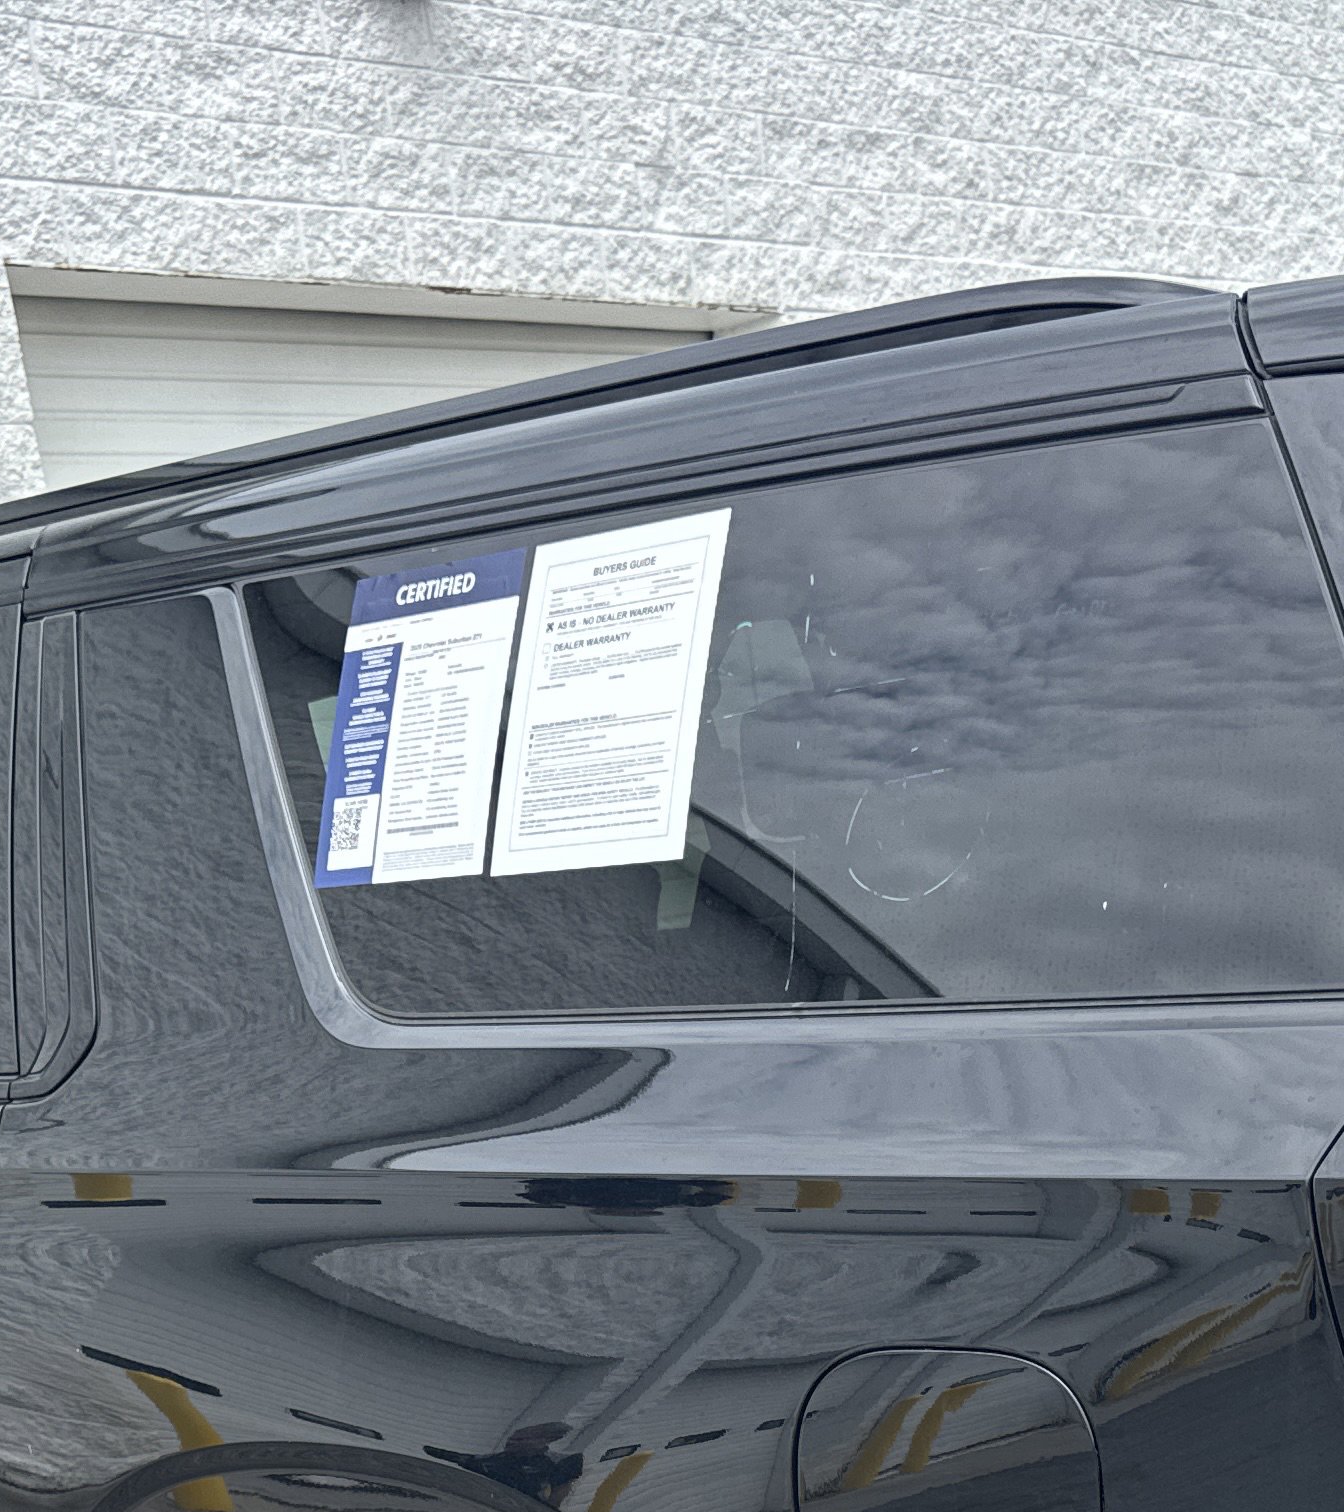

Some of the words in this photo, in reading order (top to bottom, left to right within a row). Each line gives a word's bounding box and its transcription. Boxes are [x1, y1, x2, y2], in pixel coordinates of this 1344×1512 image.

[593, 561, 628, 577] BUYERS
[629, 555, 657, 571] GUIDE
[395, 571, 476, 606] CERTIFIED
[557, 621, 568, 630] AS
[582, 615, 595, 626] NO
[596, 610, 628, 624] DEALER
[629, 602, 675, 618] WARRANTY
[553, 639, 584, 652] DEALER
[586, 632, 632, 647] WARRANTY
